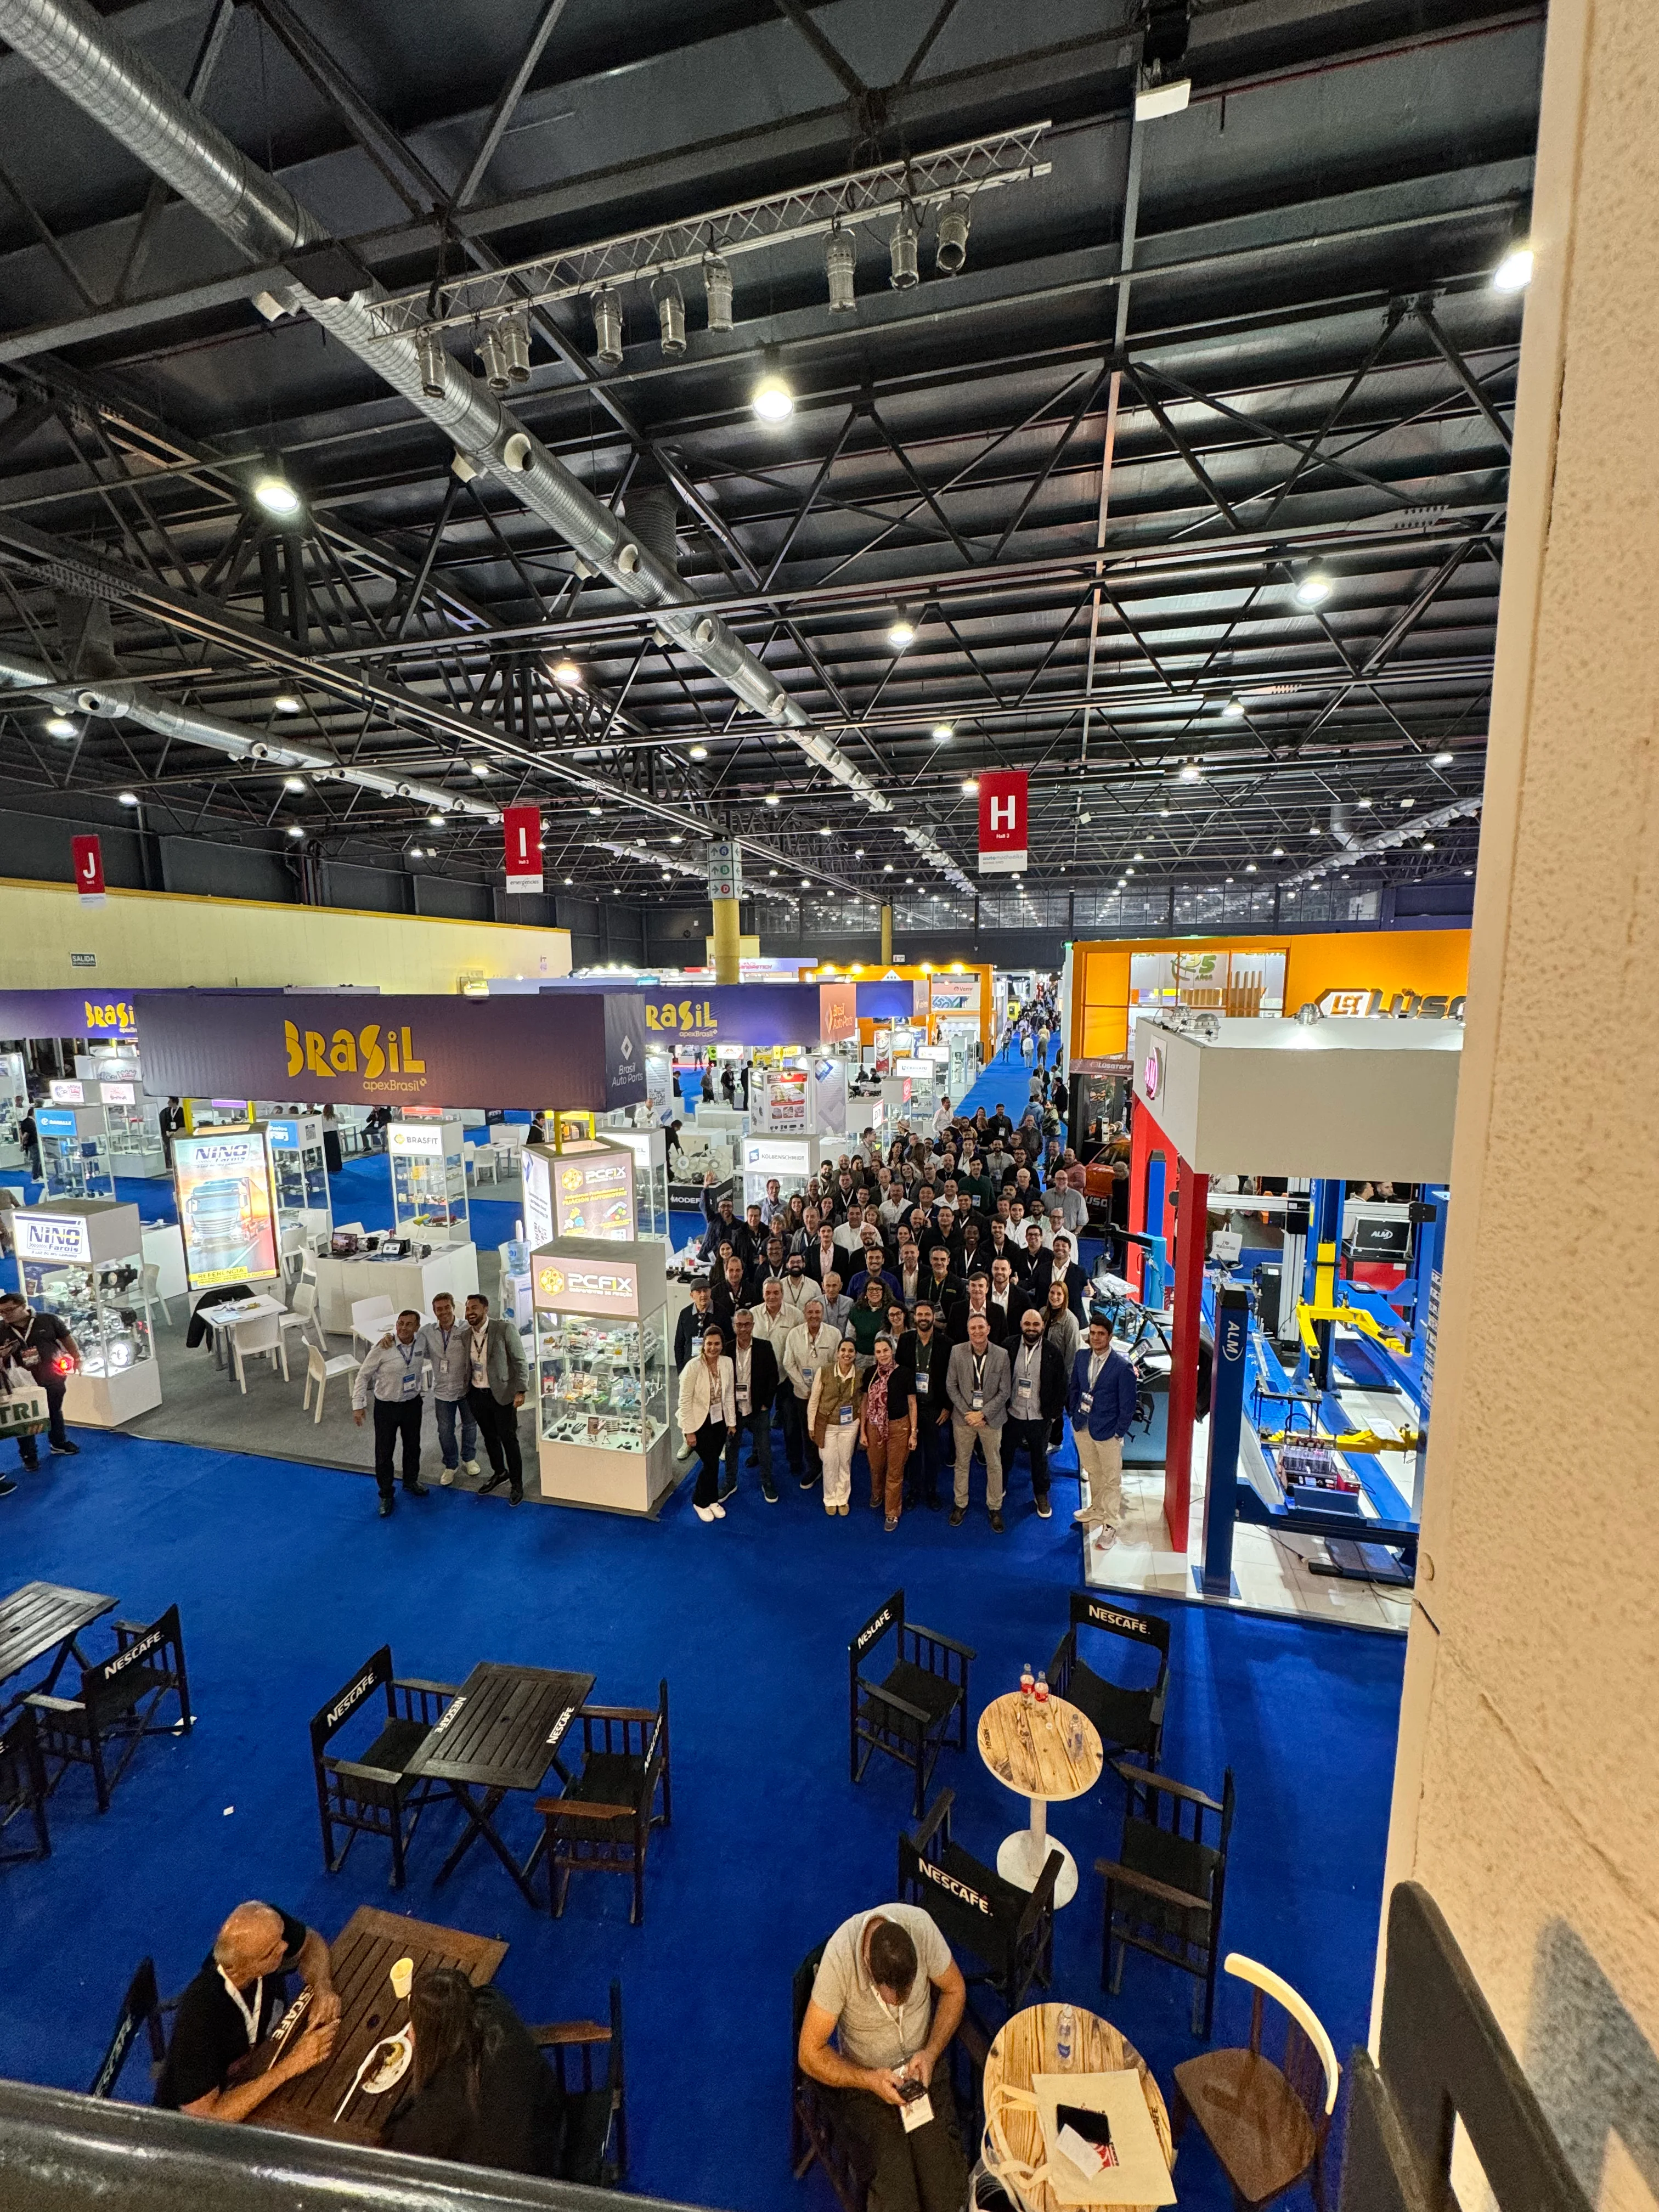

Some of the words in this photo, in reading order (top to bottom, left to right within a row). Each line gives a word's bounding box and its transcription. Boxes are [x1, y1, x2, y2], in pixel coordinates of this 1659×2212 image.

[991, 795, 1015, 831] H
[519, 827, 527, 857] I
[83, 852, 96, 878] J
[619, 1062, 636, 1076] Brasil
[363, 1079, 420, 1092] apexBrasil
[612, 1075, 627, 1087] Auto
[628, 1072, 644, 1084] Parts
[407, 1136, 438, 1144] BRASFIT
[1371, 1231, 1391, 1239] ALM
[568, 1273, 633, 1292] PCFIX
[1225, 1320, 1241, 1356] ALM
